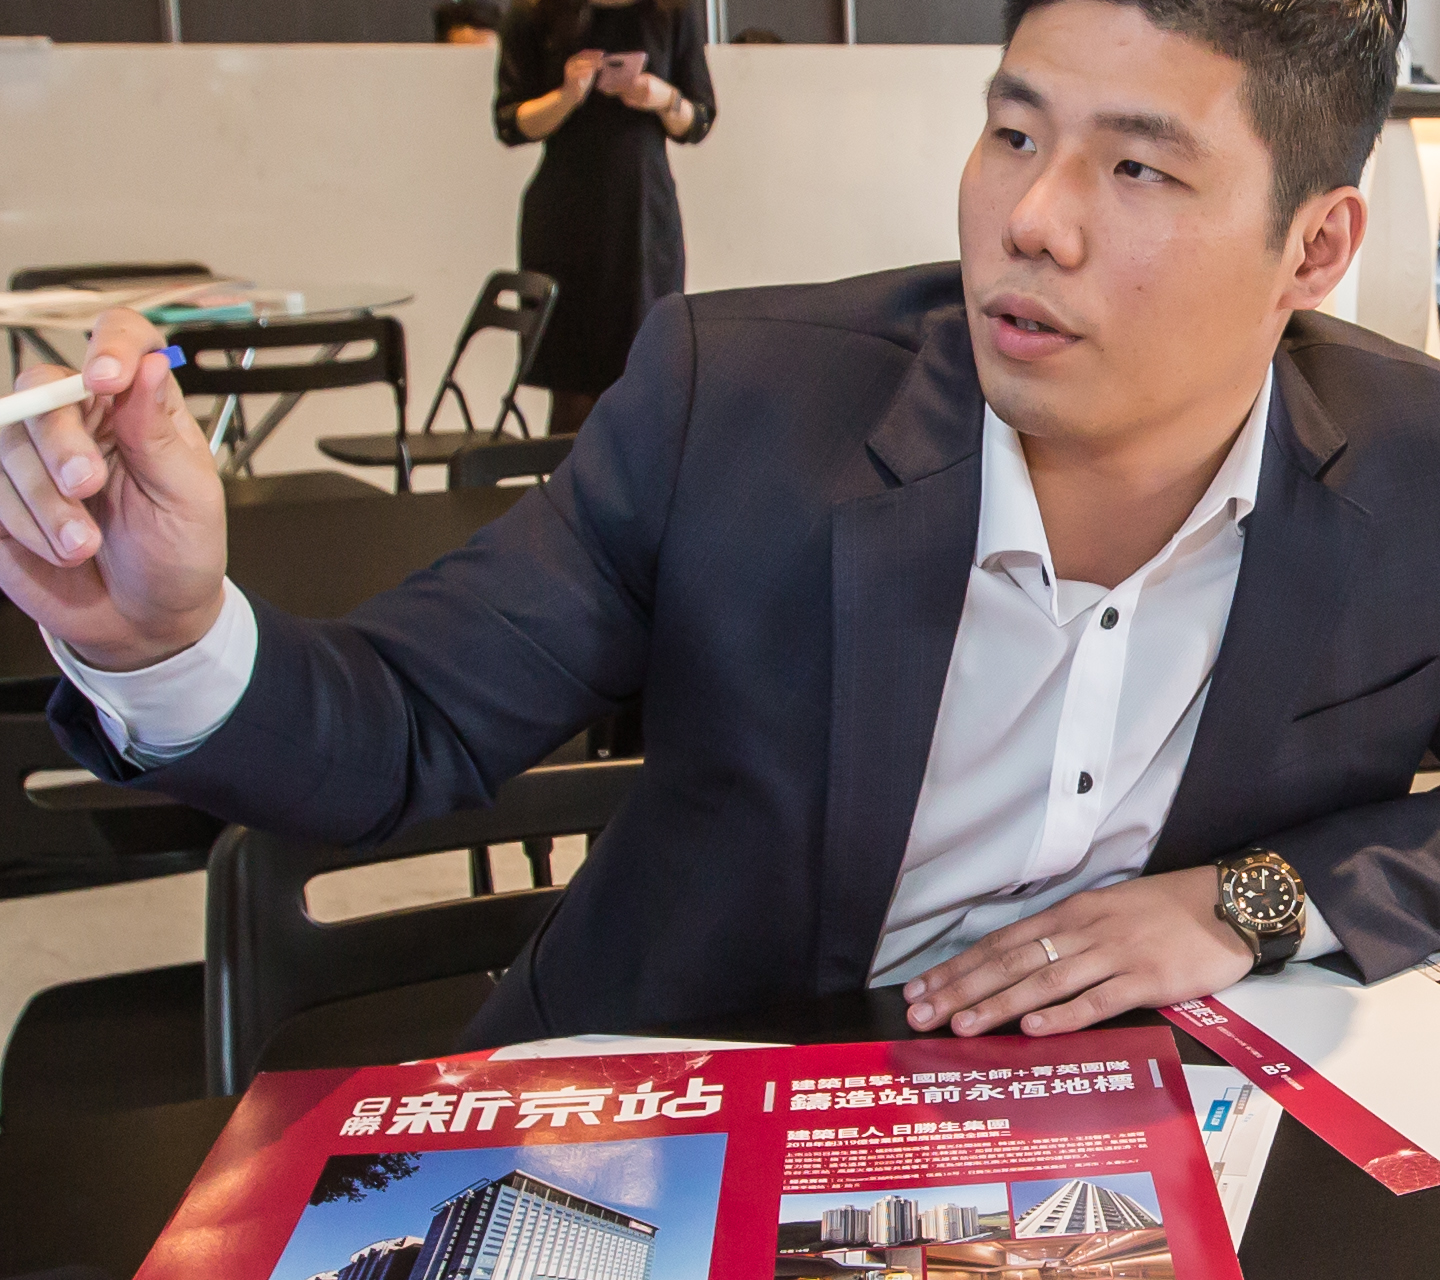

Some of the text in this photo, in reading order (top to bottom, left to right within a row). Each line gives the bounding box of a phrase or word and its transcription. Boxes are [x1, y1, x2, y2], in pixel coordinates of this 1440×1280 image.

[1261, 1062, 1291, 1076] B5
[339, 1077, 725, 1136] 日勝 新京站
[788, 1072, 1136, 1112] 鑄造站前永恆地標
[786, 1118, 1011, 1142] 建築巨人 日勝生集團
